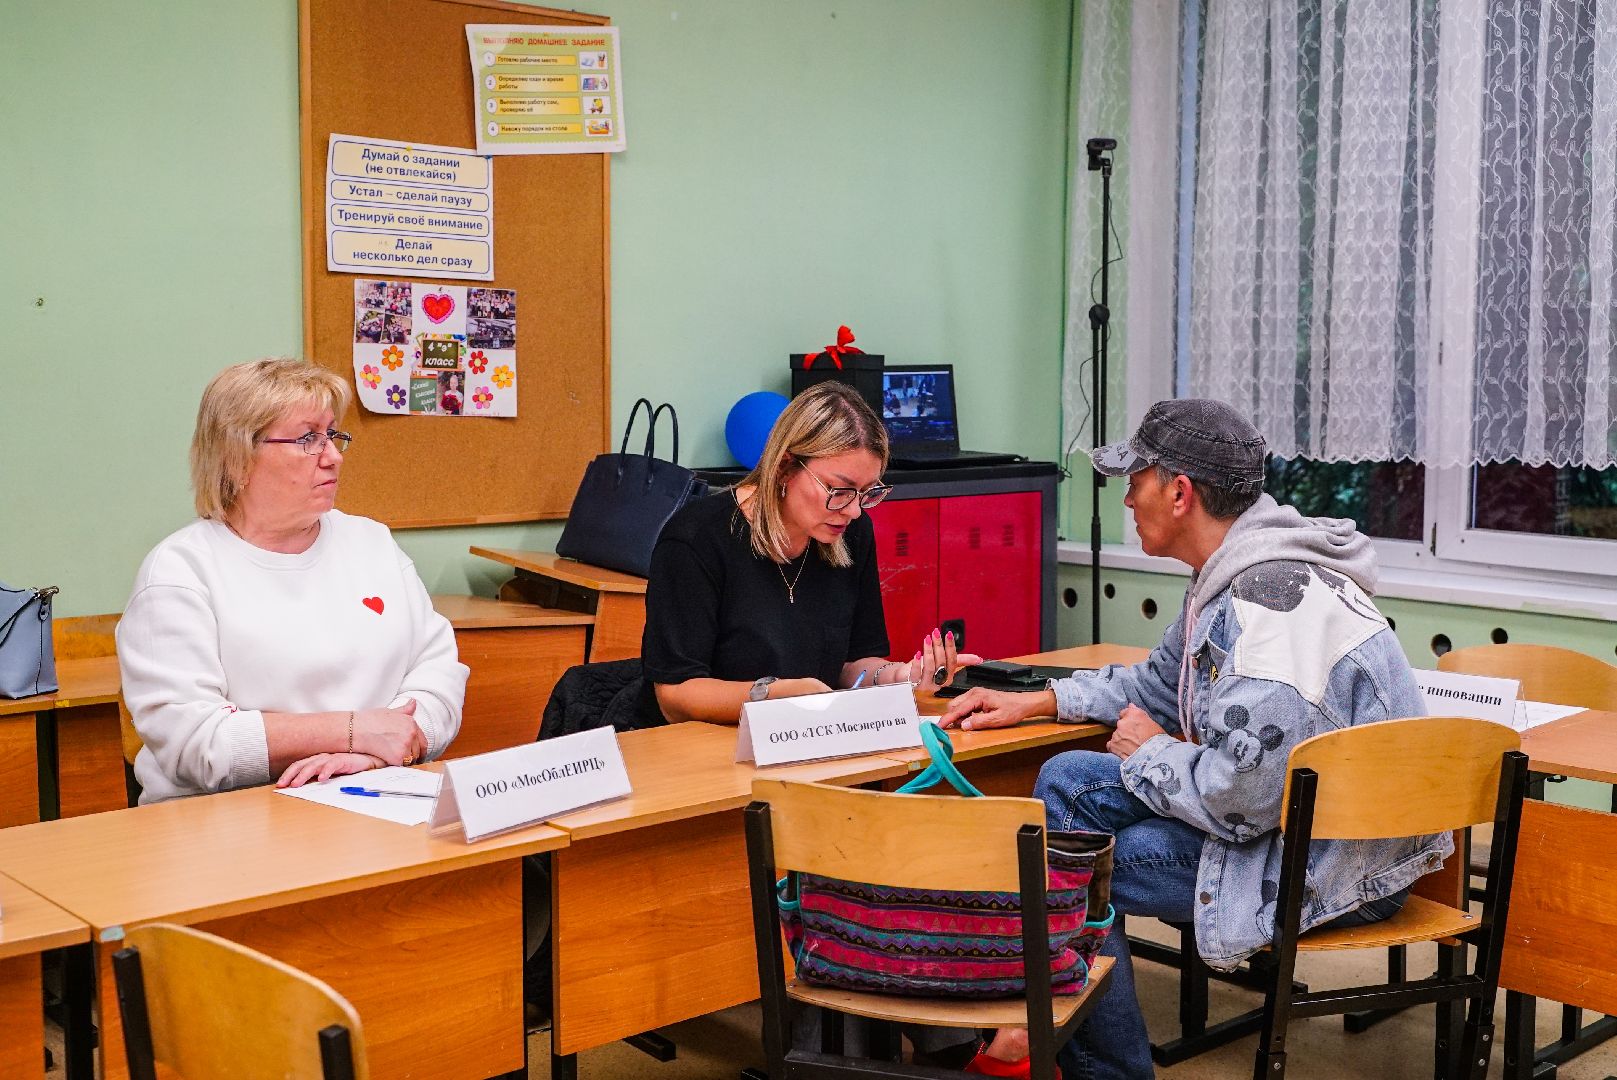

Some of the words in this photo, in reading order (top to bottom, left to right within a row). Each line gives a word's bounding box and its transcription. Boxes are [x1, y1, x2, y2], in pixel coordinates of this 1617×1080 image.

[527, 38, 568, 46] ДОМАШНЕЕ
[361, 148, 400, 162] Думай
[402, 154, 410, 163] о
[412, 156, 460, 168] задании
[365, 163, 383, 174] (не
[386, 165, 457, 183] отвлекайся)
[349, 185, 383, 197] Устал
[396, 191, 438, 202] сделай
[441, 195, 473, 207] паузу
[337, 209, 395, 224] Тренируй
[397, 215, 425, 225] своё
[428, 219, 483, 230] внимание
[395, 238, 433, 251] Делай
[352, 251, 414, 263] несколько
[416, 255, 438, 265] дел
[441, 256, 473, 268] сразу
[428, 341, 435, 352] 4
[1426, 686, 1502, 706] инновации
[769, 729, 799, 744] ООО
[835, 717, 893, 735] Мосэнерго
[475, 779, 508, 799] ООО
[511, 757, 606, 789] «МосОблЕИРЦ»
